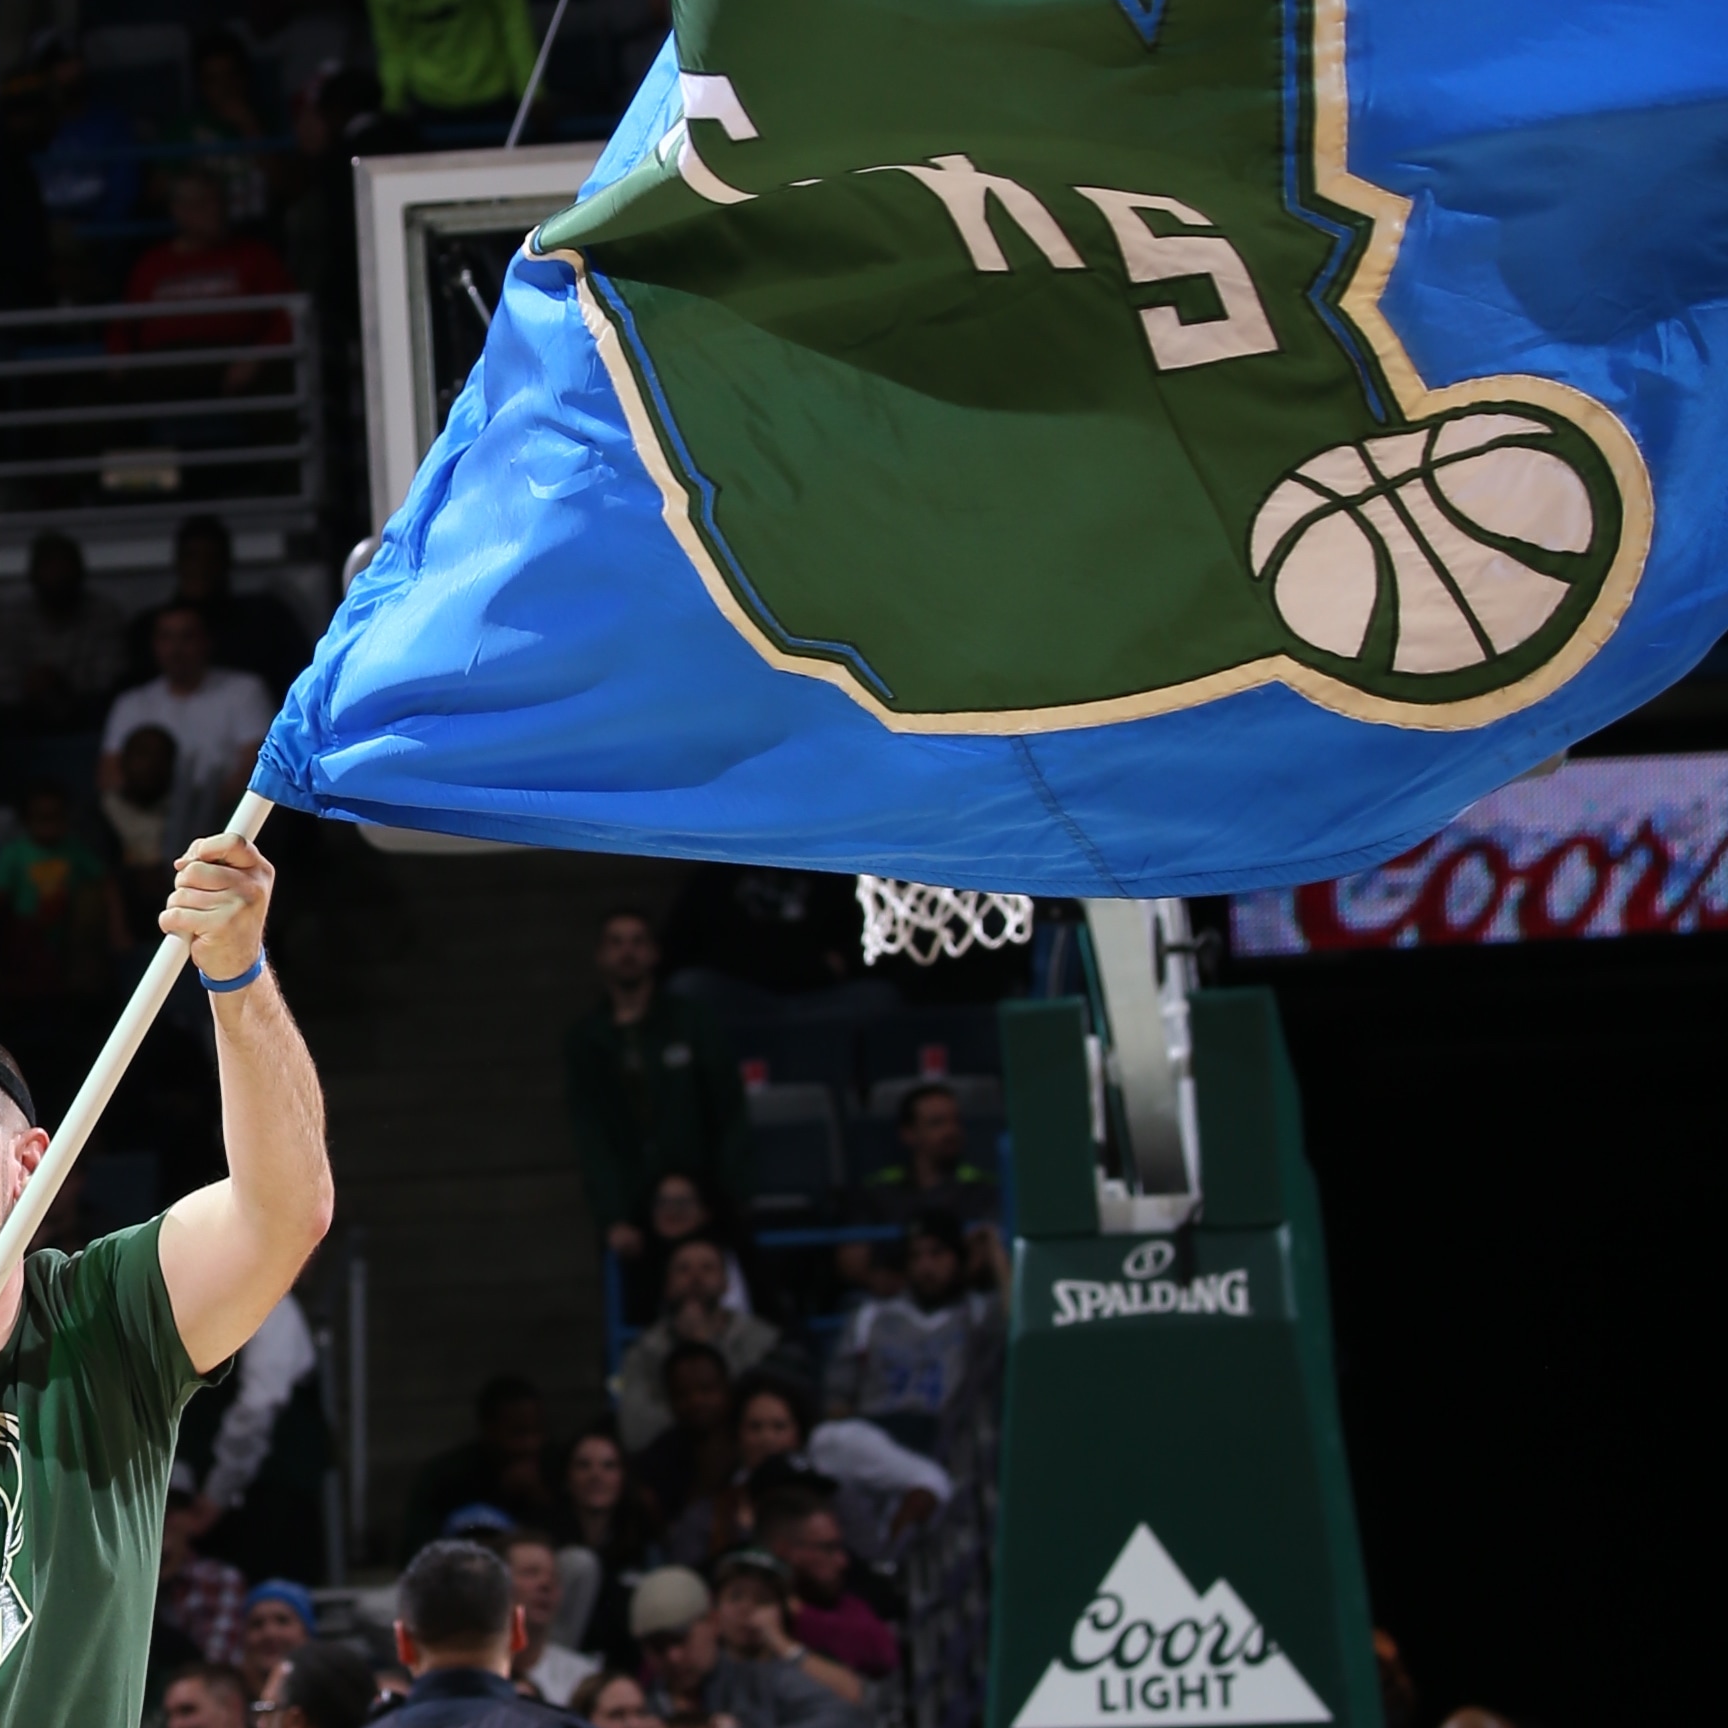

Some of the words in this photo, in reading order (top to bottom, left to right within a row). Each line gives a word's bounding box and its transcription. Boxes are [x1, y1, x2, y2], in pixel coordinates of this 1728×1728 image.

[1051, 1268, 1250, 1327] SPALDING
[1060, 1592, 1282, 1672] Coors
[1099, 1674, 1236, 1712] LIGHT
